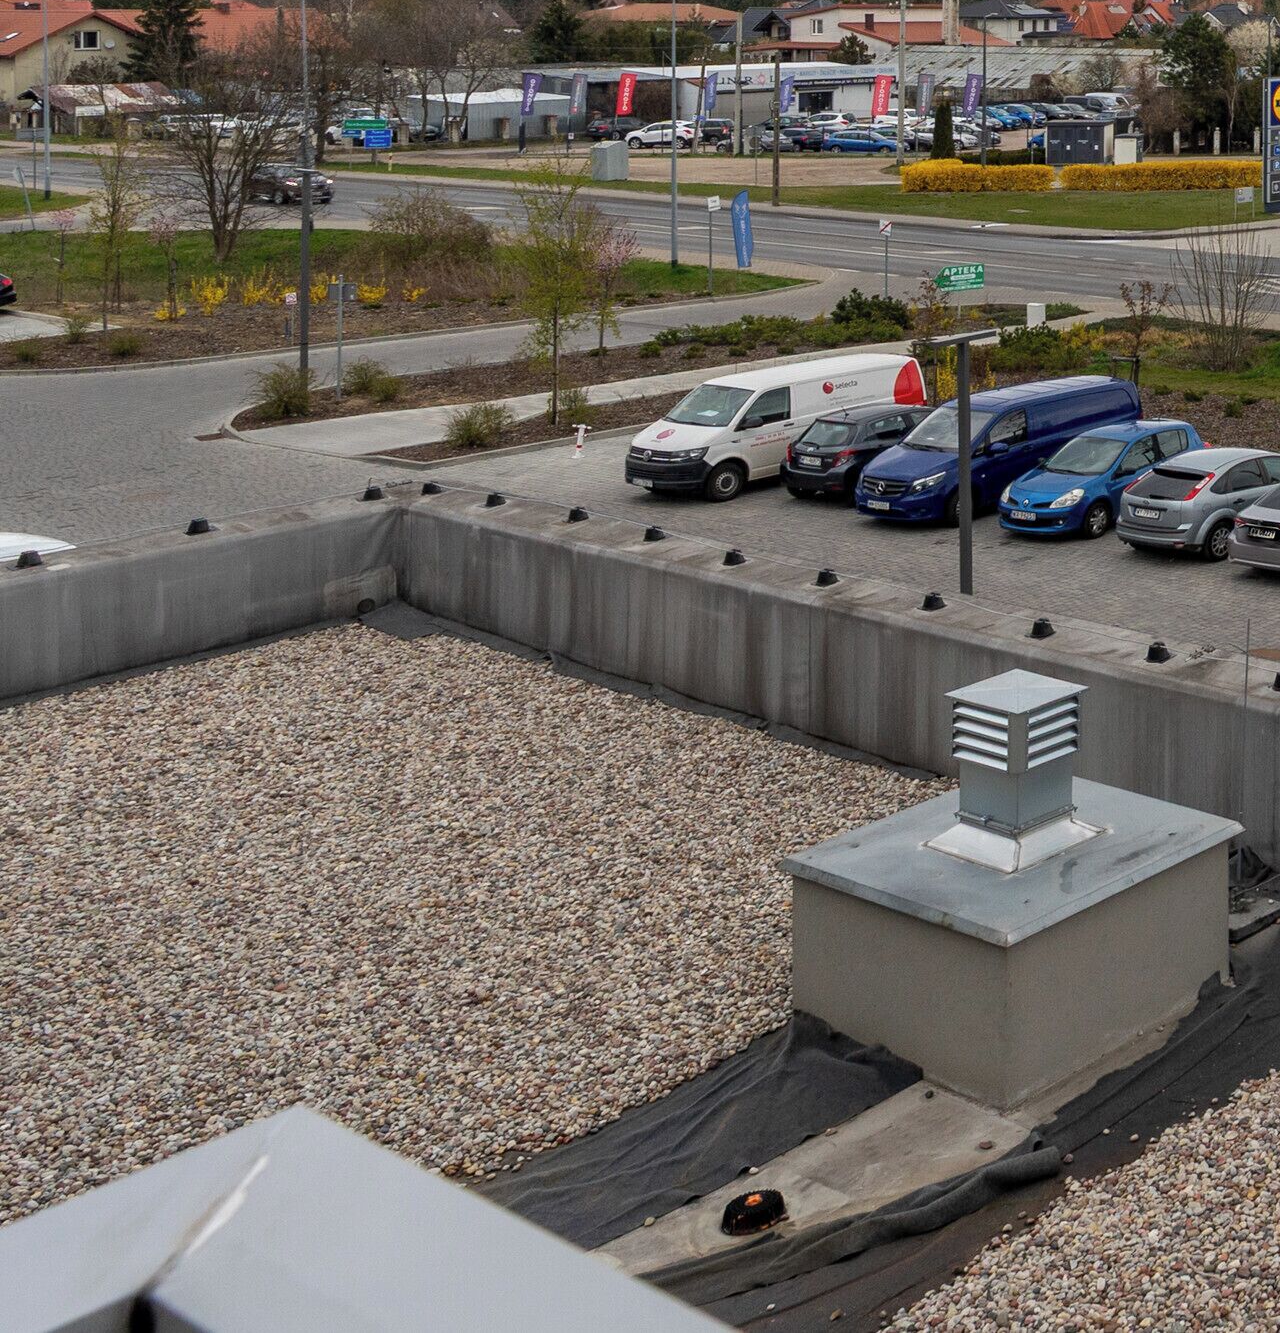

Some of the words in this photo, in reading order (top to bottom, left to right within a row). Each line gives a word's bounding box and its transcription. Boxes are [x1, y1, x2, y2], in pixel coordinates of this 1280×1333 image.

[525, 79, 536, 112] OTOMOTO
[622, 78, 630, 111] OTOMOTO
[877, 80, 886, 112] OTOMOTO
[967, 78, 977, 111] OTOMOTO
[943, 265, 984, 277] APTEKA
[835, 380, 858, 389] selecta
